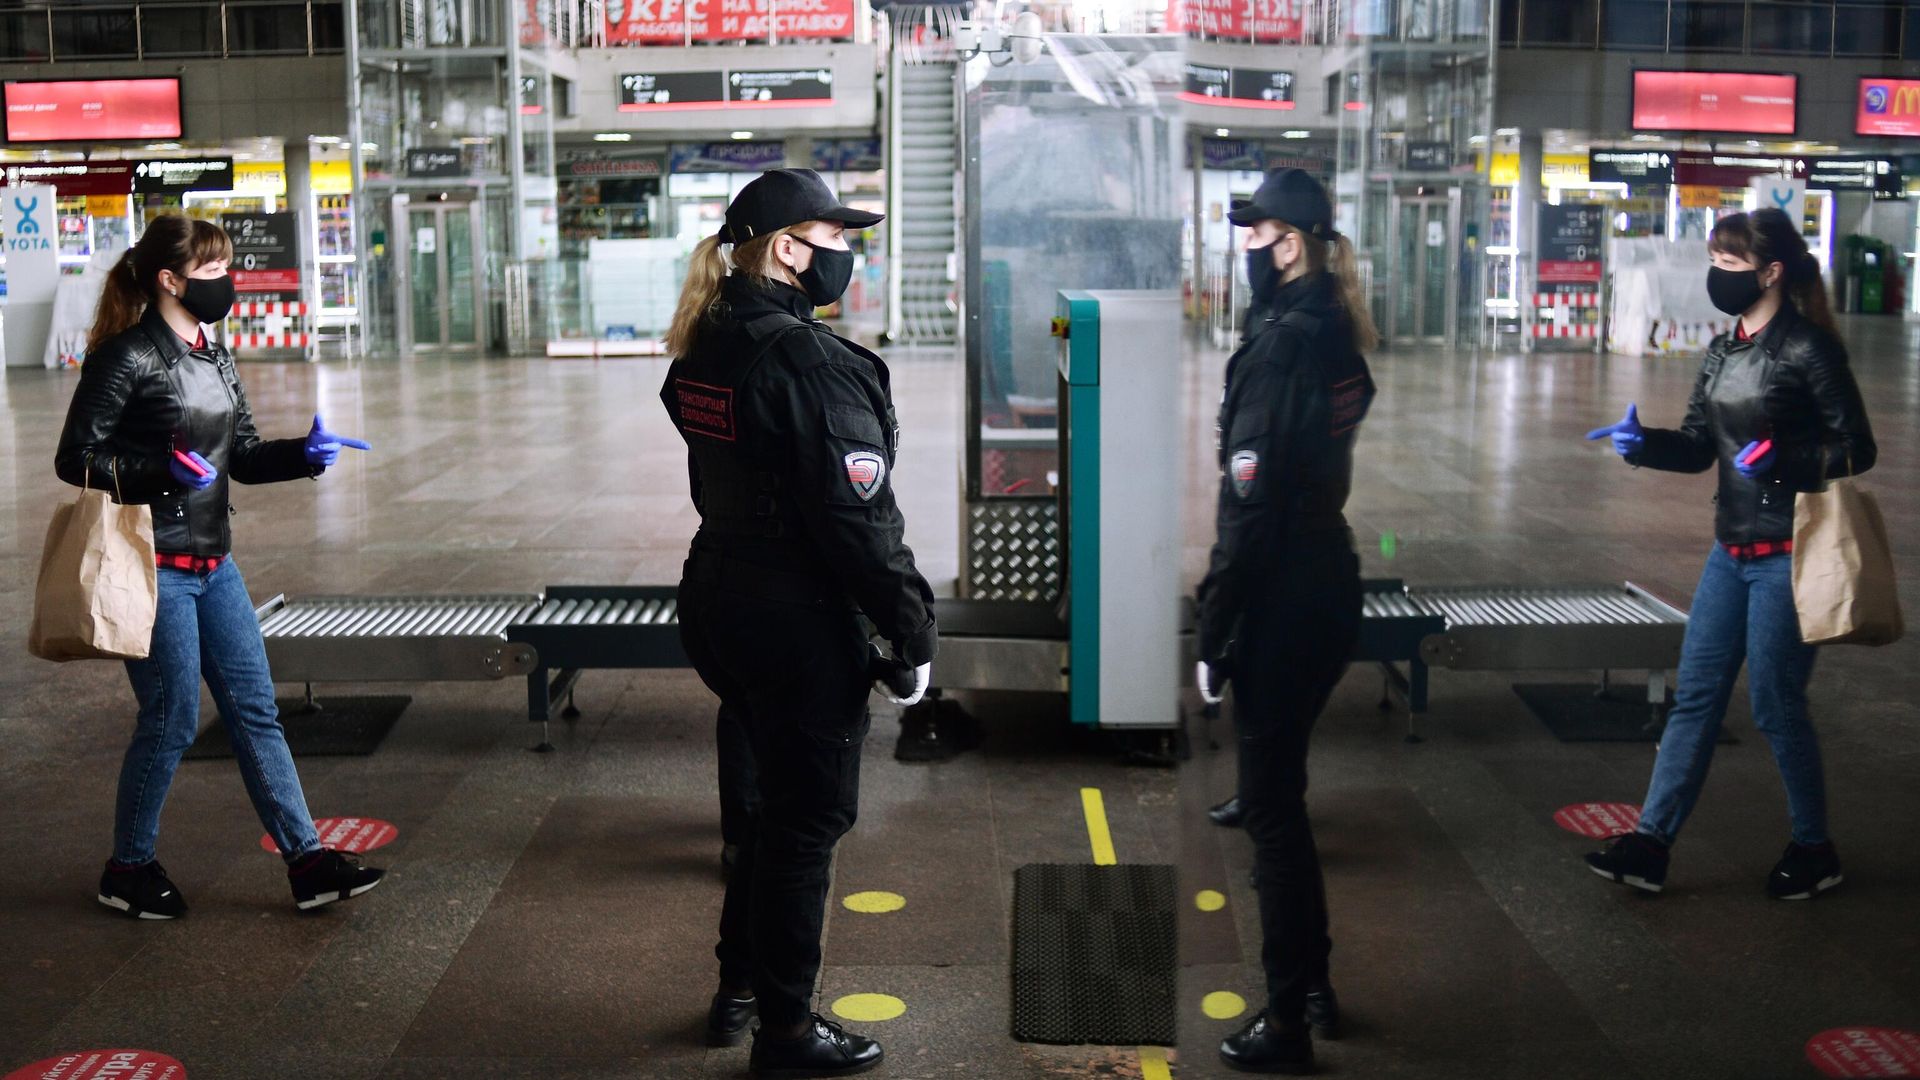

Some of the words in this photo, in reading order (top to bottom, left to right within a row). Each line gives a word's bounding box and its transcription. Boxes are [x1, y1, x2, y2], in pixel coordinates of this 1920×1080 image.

[628, 0, 708, 21] KFC
[721, 18, 739, 33] И
[742, 14, 848, 36] ДОСТАВКУ
[8, 238, 50, 251] YOTA
[90, 1052, 140, 1080] тра
